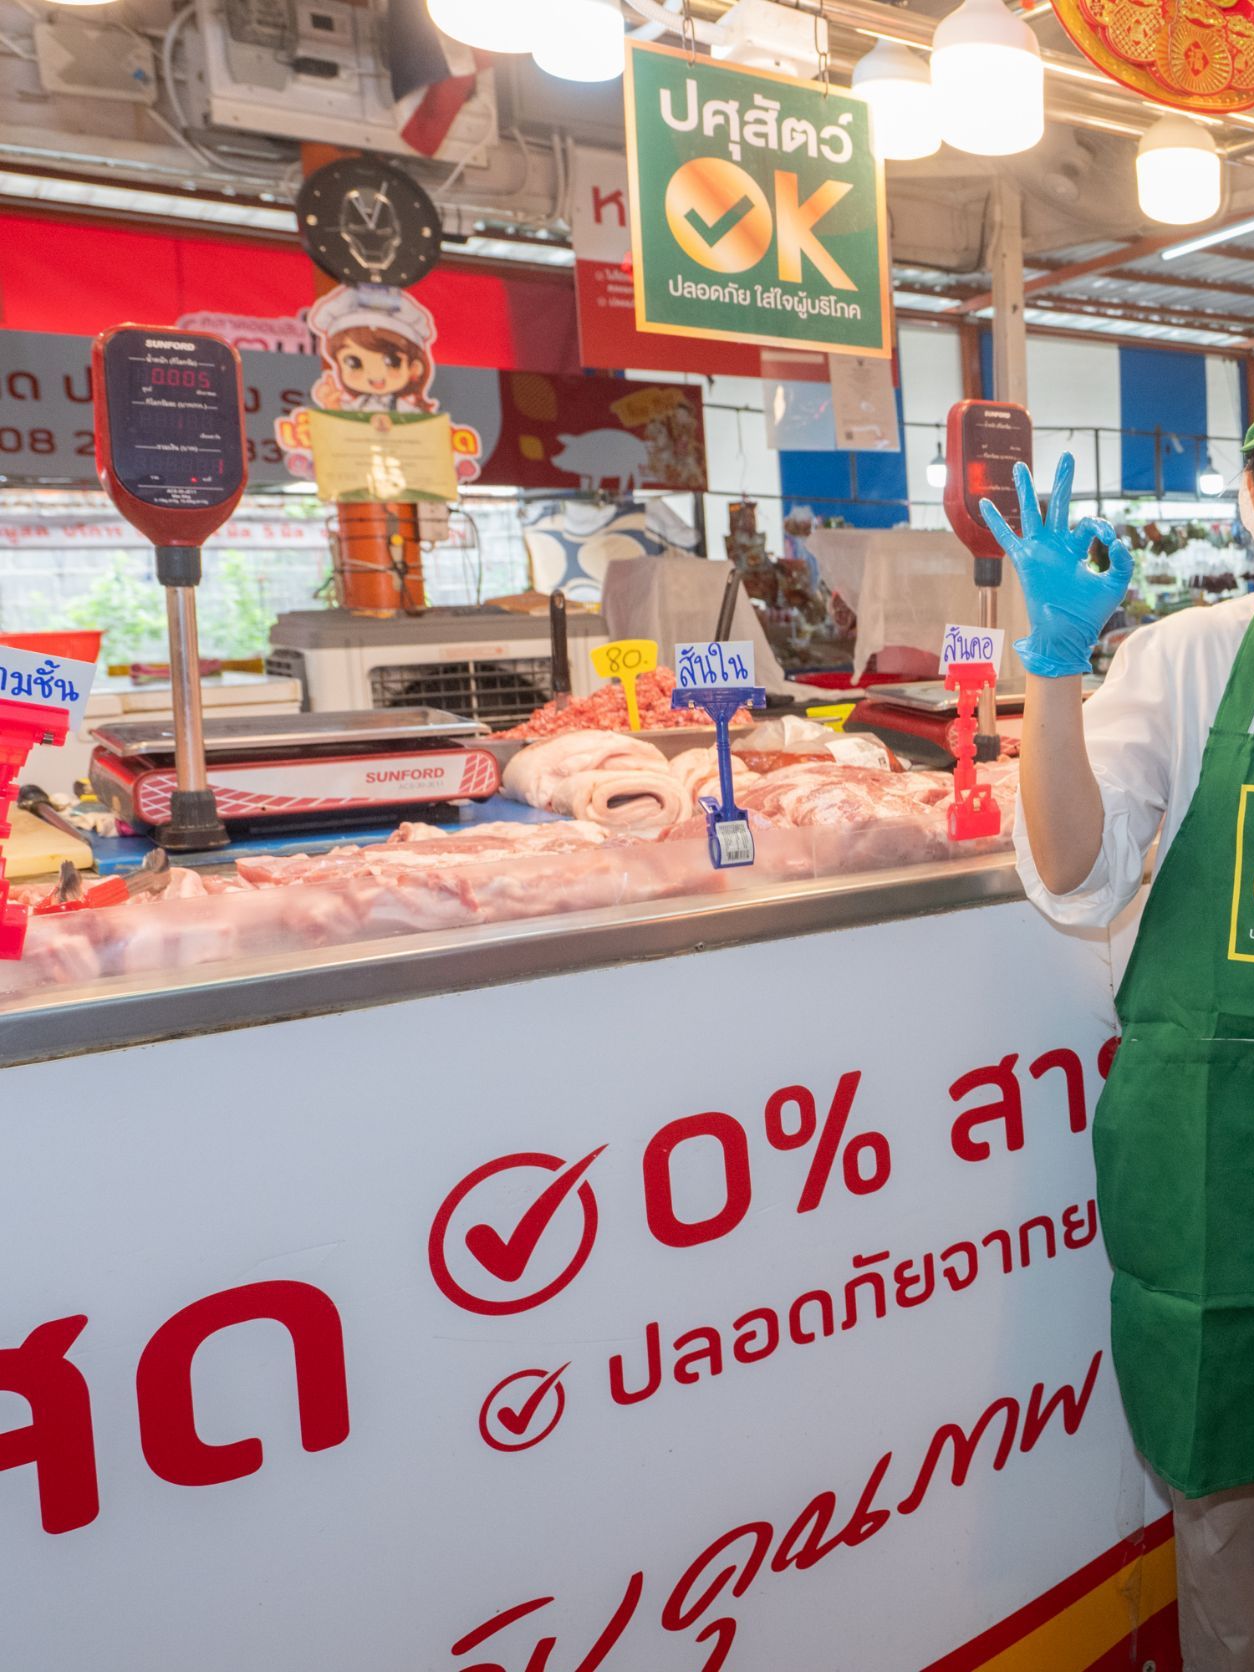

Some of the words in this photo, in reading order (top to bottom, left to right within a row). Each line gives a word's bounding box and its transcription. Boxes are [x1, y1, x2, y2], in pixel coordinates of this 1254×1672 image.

[659, 78, 854, 163] ปศุสัตว์
[665, 157, 859, 292] OK
[668, 274, 751, 306] ปลอดภัย
[754, 285, 862, 320] ใส่ใจผู้บริโภค
[145, 339, 196, 351] SUNFORD
[678, 642, 749, 688] สันใน
[944, 626, 993, 662] สันคอ
[365, 767, 445, 784] SUNFORD
[642, 1070, 892, 1249] 0%
[949, 1035, 1122, 1163] สา
